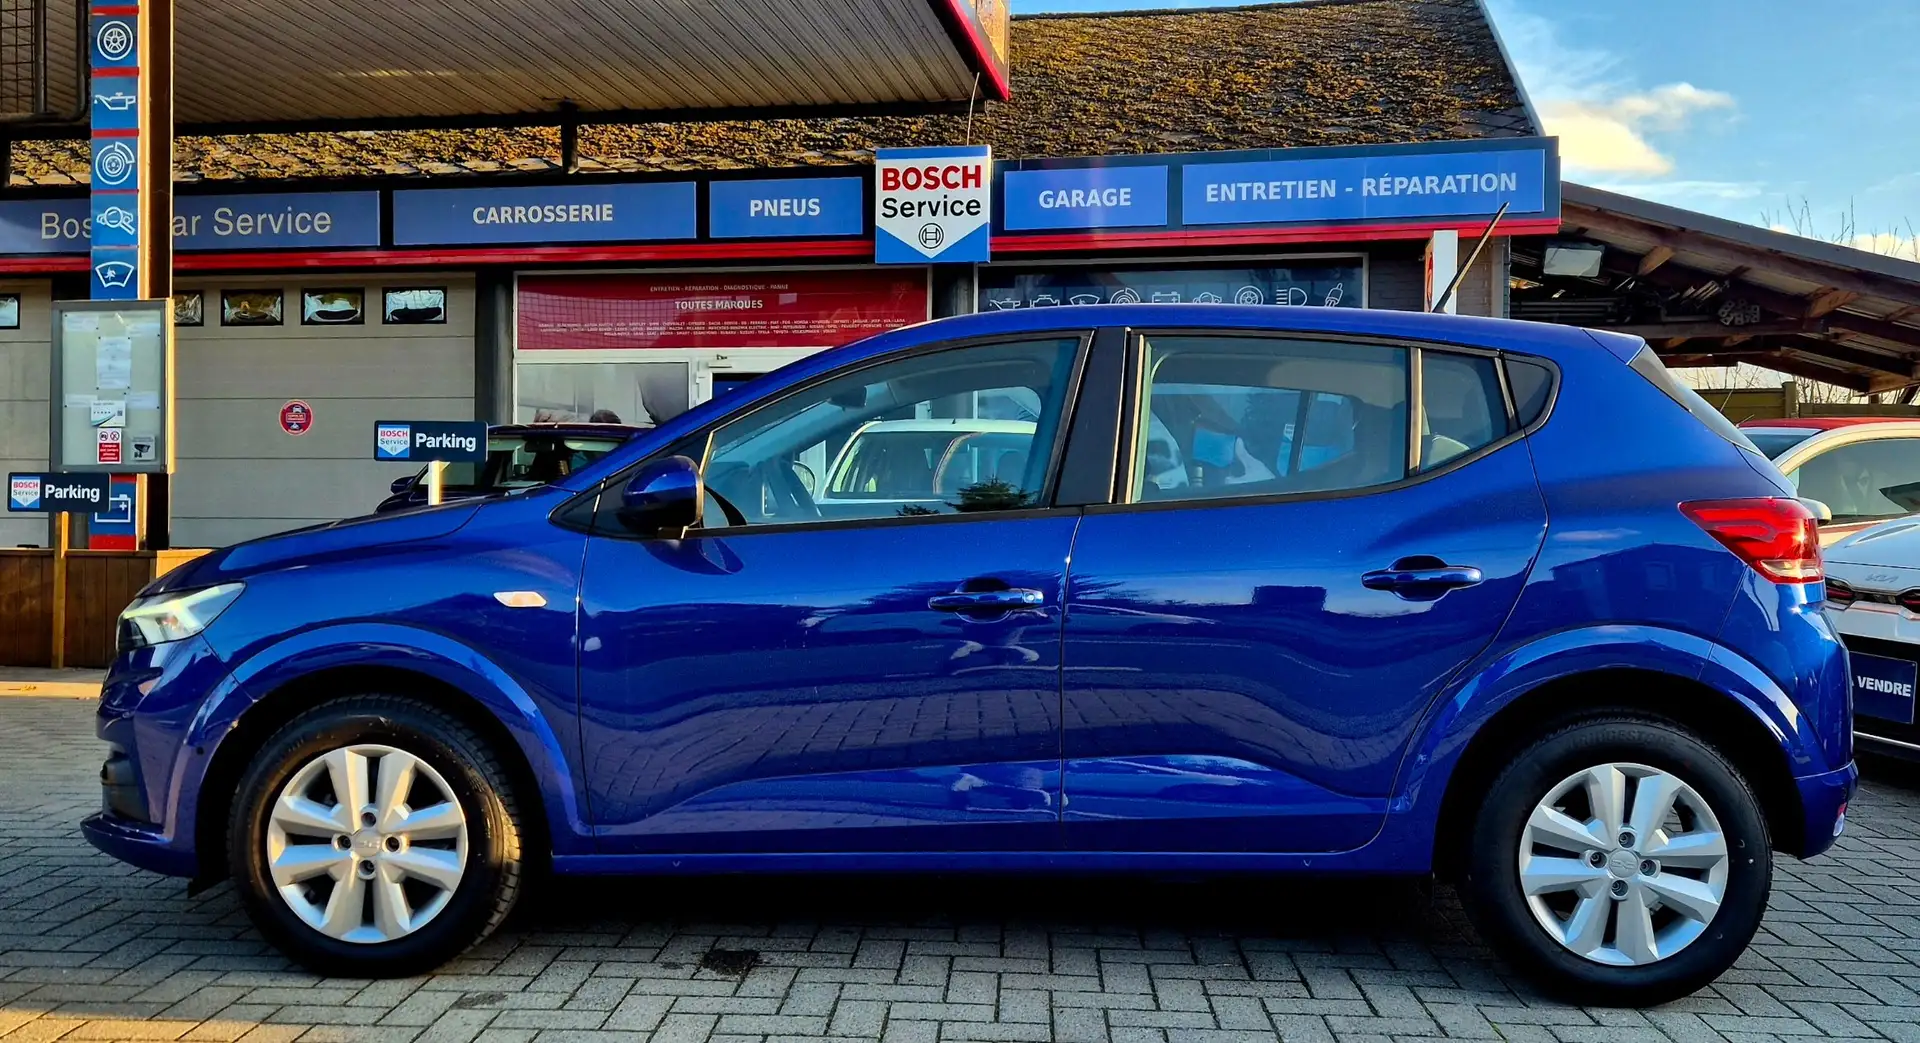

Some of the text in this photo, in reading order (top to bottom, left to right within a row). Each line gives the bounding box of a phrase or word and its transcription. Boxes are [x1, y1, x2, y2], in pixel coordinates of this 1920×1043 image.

[882, 165, 981, 191] BOSCH
[1206, 179, 1336, 202] ENTRETIEN
[1362, 172, 1517, 197] RÉPARATION
[749, 198, 821, 217] PNEUS
[882, 194, 981, 218] Service
[1038, 188, 1132, 209] GARAGE
[41, 206, 332, 240] Bos ar Service
[472, 204, 614, 224] CARROSSERIE
[675, 299, 764, 311] TOUTES MARQUES
[380, 437, 408, 446] Service
[415, 432, 477, 452] Parking
[13, 481, 39, 489] BOSCH
[44, 484, 100, 502] Parking
[1856, 675, 1912, 697] VENDRE
